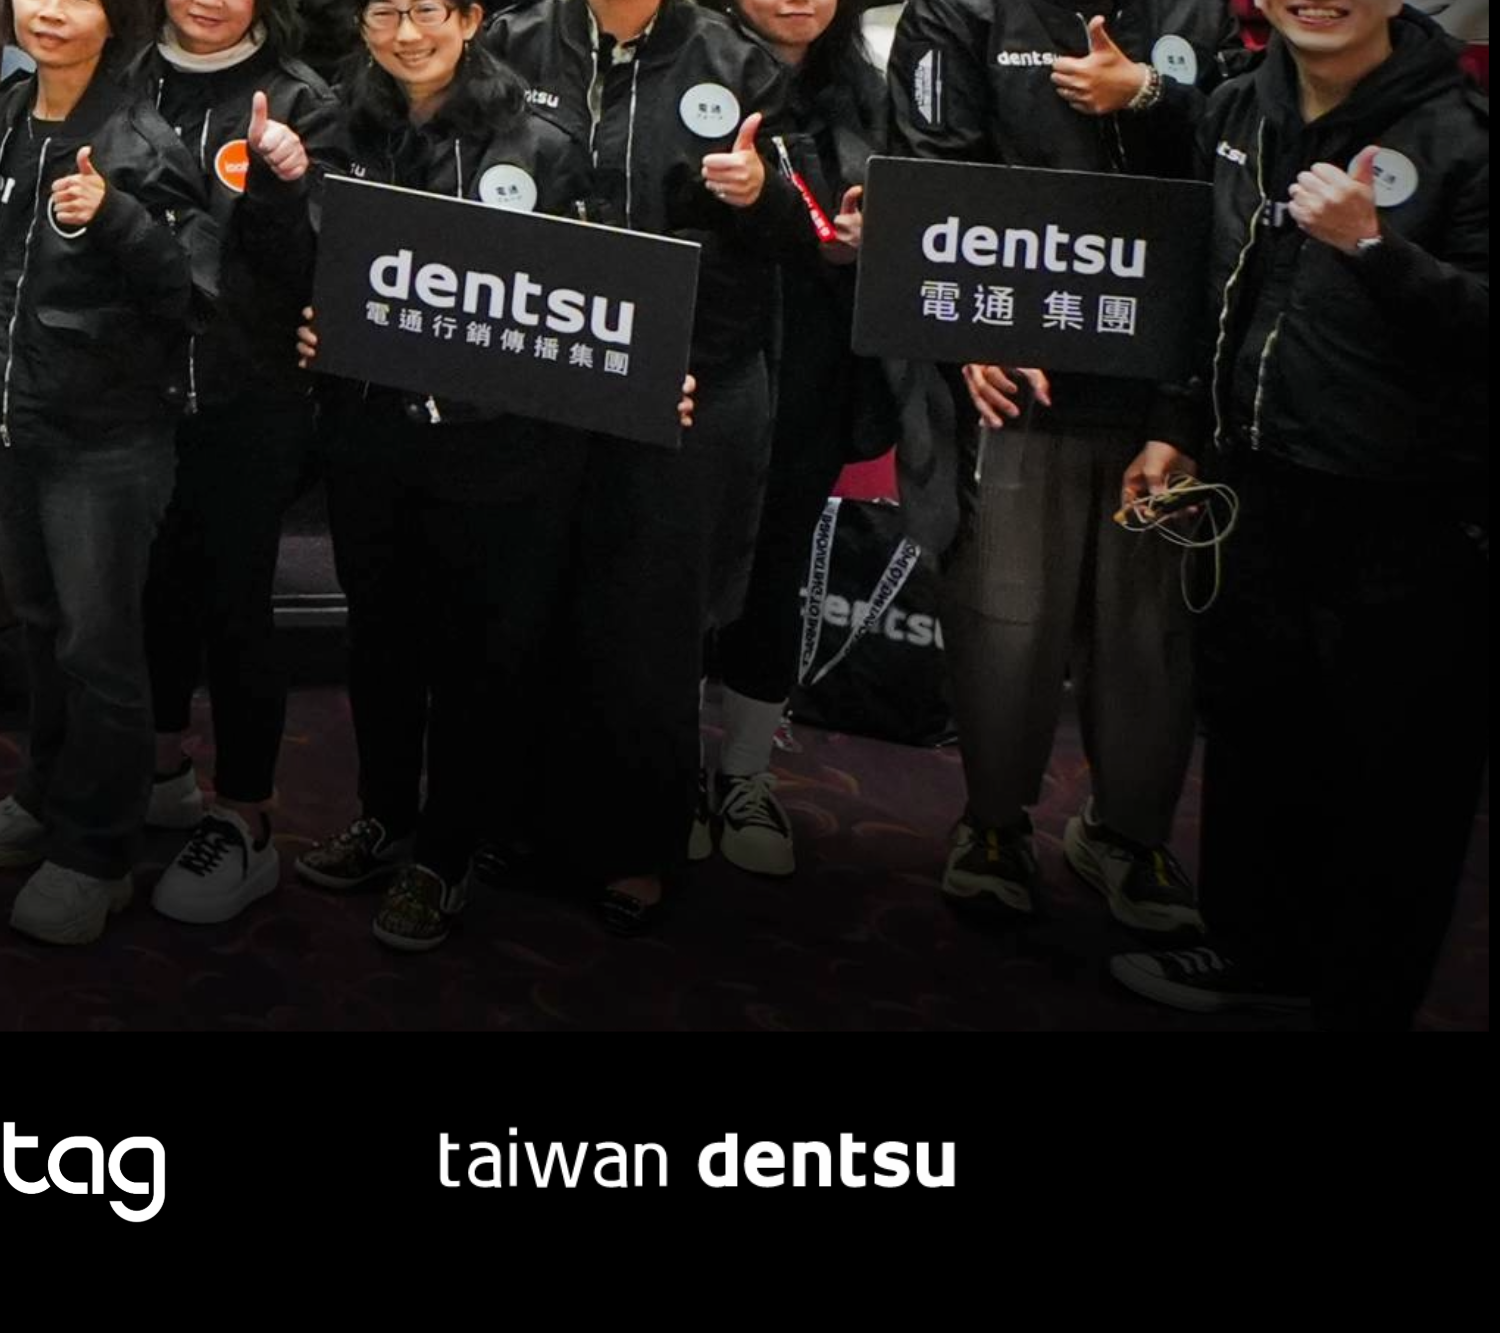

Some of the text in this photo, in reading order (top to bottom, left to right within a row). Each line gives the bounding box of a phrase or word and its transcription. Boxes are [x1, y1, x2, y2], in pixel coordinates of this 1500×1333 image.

[998, 50, 1059, 67] dents
[921, 216, 1147, 278] dentsu
[369, 248, 636, 346] dentsu
[921, 280, 1138, 337] 電通集團
[365, 300, 630, 376] 電通行銷傳播集團
